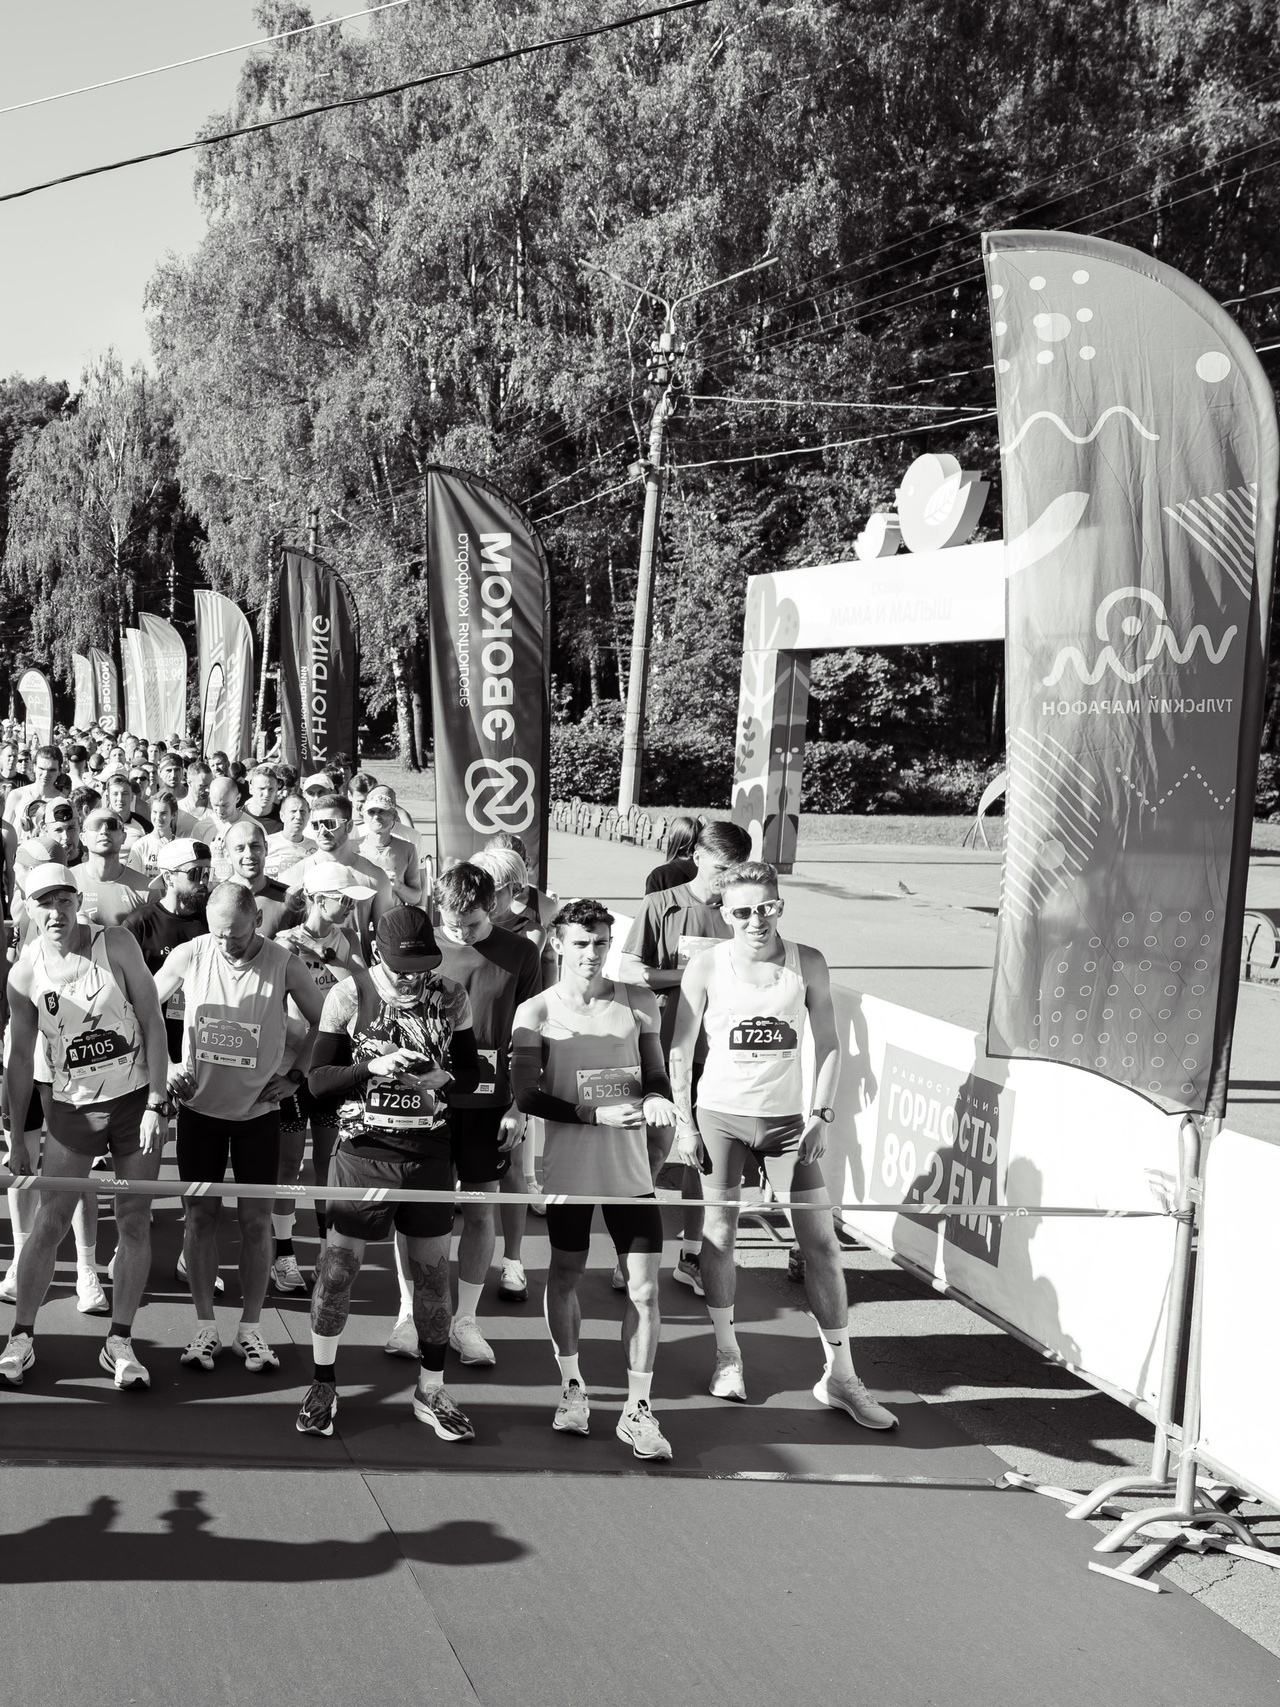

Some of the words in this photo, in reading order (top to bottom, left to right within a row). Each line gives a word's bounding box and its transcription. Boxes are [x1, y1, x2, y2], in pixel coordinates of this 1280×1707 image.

[210, 1032, 244, 1049] 5239
[745, 1029, 783, 1044] 7234
[78, 1038, 114, 1059] 7105
[595, 1082, 630, 1098] 5256
[382, 1092, 421, 1109] 7268
[888, 1082, 998, 1165] ГОРДОСТЬ
[881, 1132, 945, 1205] 89.2
[946, 1160, 992, 1238] FM
